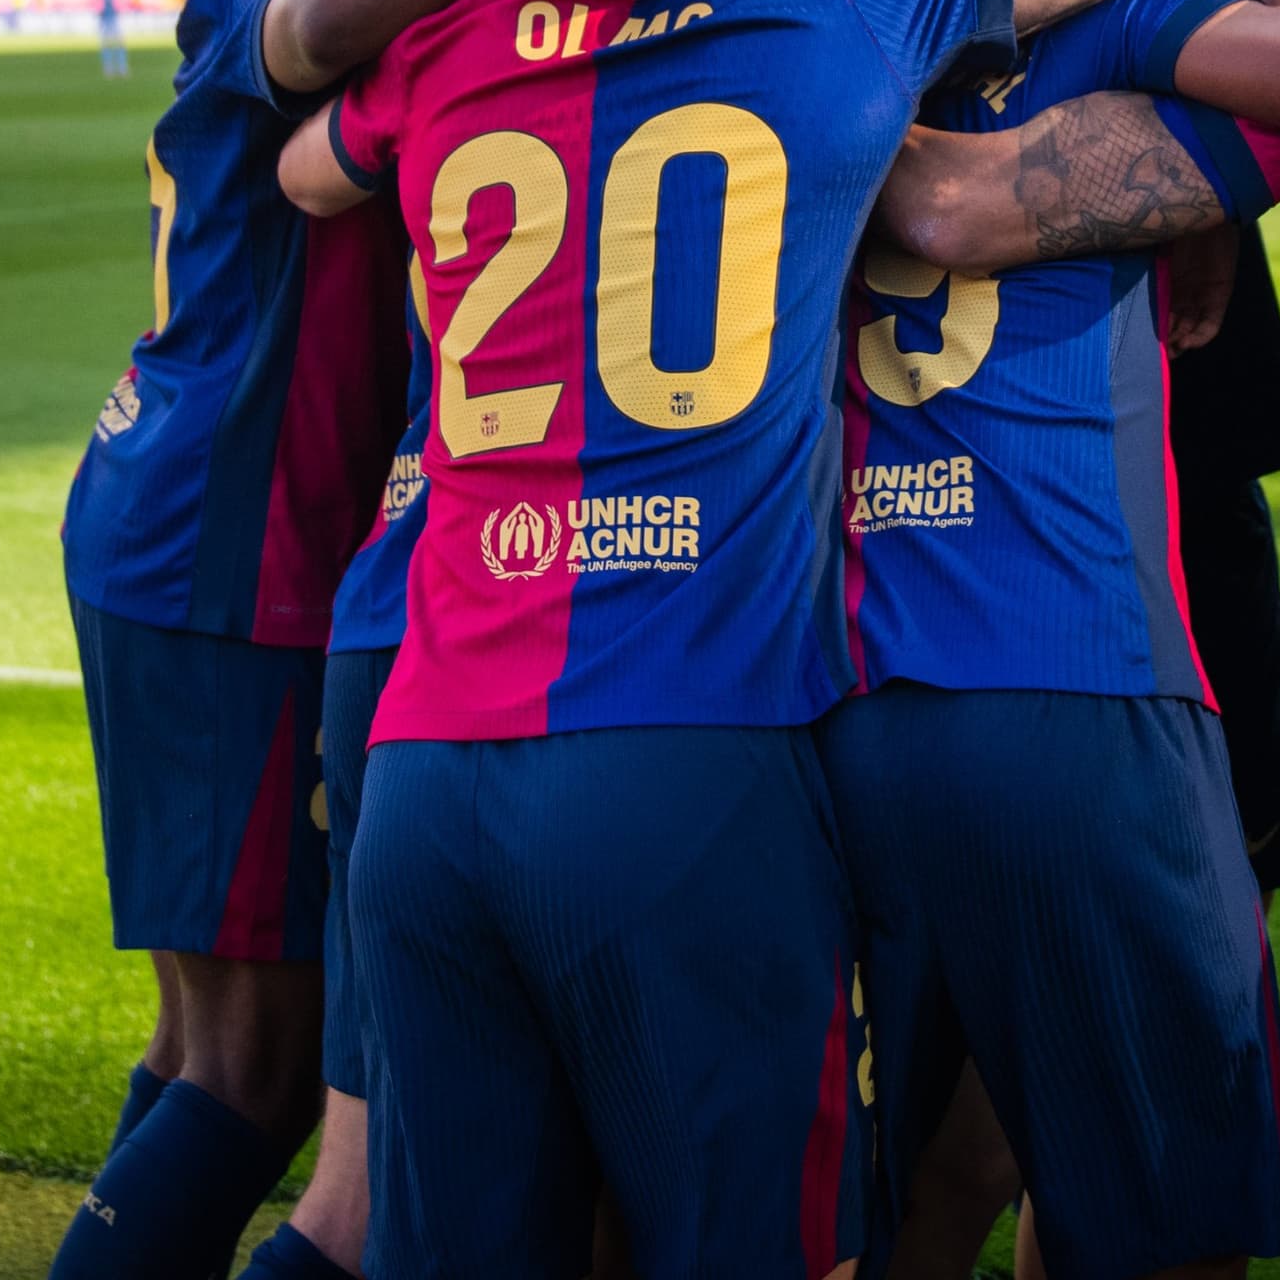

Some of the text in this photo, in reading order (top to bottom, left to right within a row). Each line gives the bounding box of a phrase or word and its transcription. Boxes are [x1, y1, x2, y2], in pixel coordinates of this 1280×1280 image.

[430, 102, 788, 460] 20
[851, 455, 974, 495] UNHCR
[567, 495, 701, 530] UNHCR
[848, 486, 975, 524] ACNUR
[848, 524, 870, 534] The
[871, 520, 887, 533] UN
[932, 516, 974, 529] Agency
[566, 526, 700, 561] ACNUR
[567, 558, 699, 574] The UN Refugee Agency
